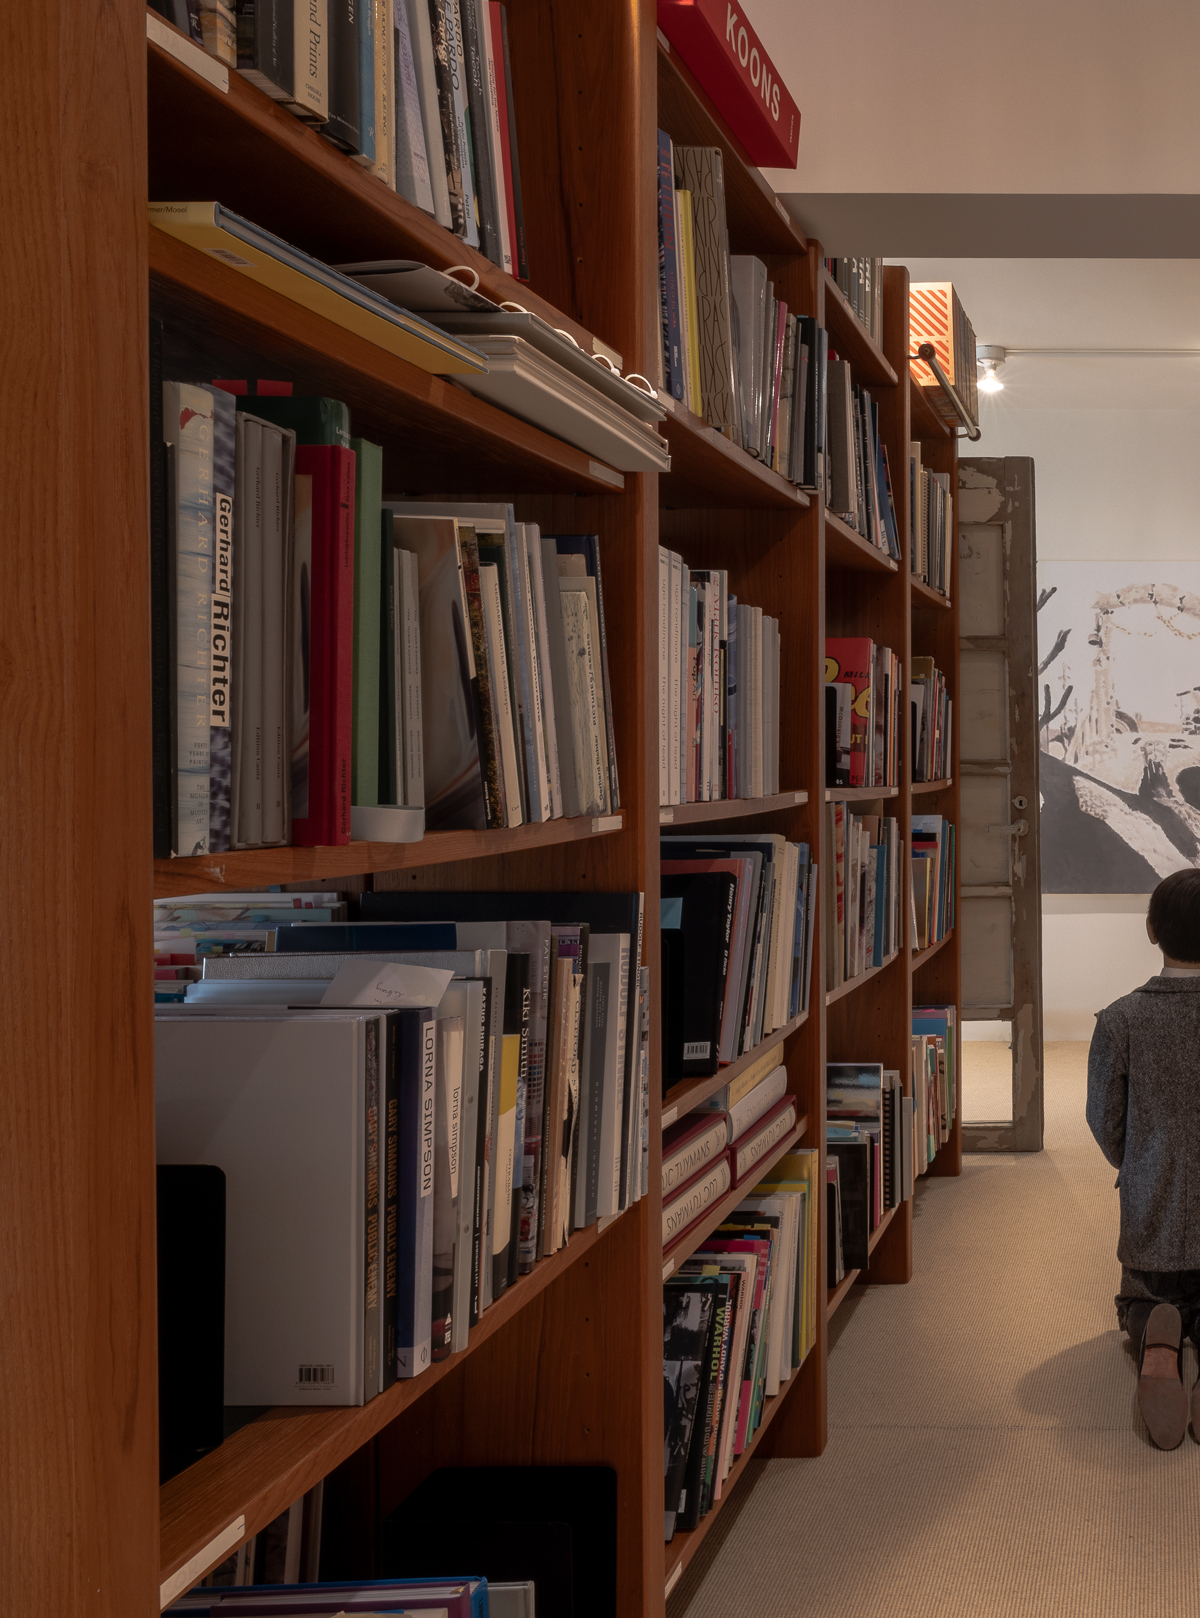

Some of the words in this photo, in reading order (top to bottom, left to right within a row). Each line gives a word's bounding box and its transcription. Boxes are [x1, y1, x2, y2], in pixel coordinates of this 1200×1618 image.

[447, 8, 460, 91] PARDO
[726, 2, 780, 121] KOONS
[148, 206, 187, 214] rmer/Mosel
[198, 424, 210, 586] GERHARD
[216, 497, 232, 593] Gerhard
[494, 583, 502, 626] GERHARD
[196, 592, 208, 727] RICHTER
[211, 596, 230, 724] Richter
[497, 627, 505, 666] RICHTER
[501, 667, 510, 716] Landscapes
[728, 882, 736, 912] Henry
[725, 913, 734, 944] Taylor
[522, 987, 531, 1025] Kiki
[424, 1026, 434, 1092] LORNA
[519, 1027, 529, 1079] Smith
[388, 1098, 397, 1131] GARY
[452, 1086, 461, 1121] lorna
[776, 1116, 788, 1134] LUC
[387, 1134, 397, 1199] SIMMONS
[422, 1099, 433, 1191] SIMPSON
[449, 1122, 459, 1175] simpson
[750, 1127, 777, 1162] TUYMANS
[704, 1179, 718, 1200] LUC
[387, 1204, 397, 1252] PUBLIC
[667, 1195, 703, 1236] TUYMANS
[386, 1254, 396, 1299] ENEMY
[738, 1279, 746, 1310] WARHOL
[709, 1306, 725, 1381] WARHOL
